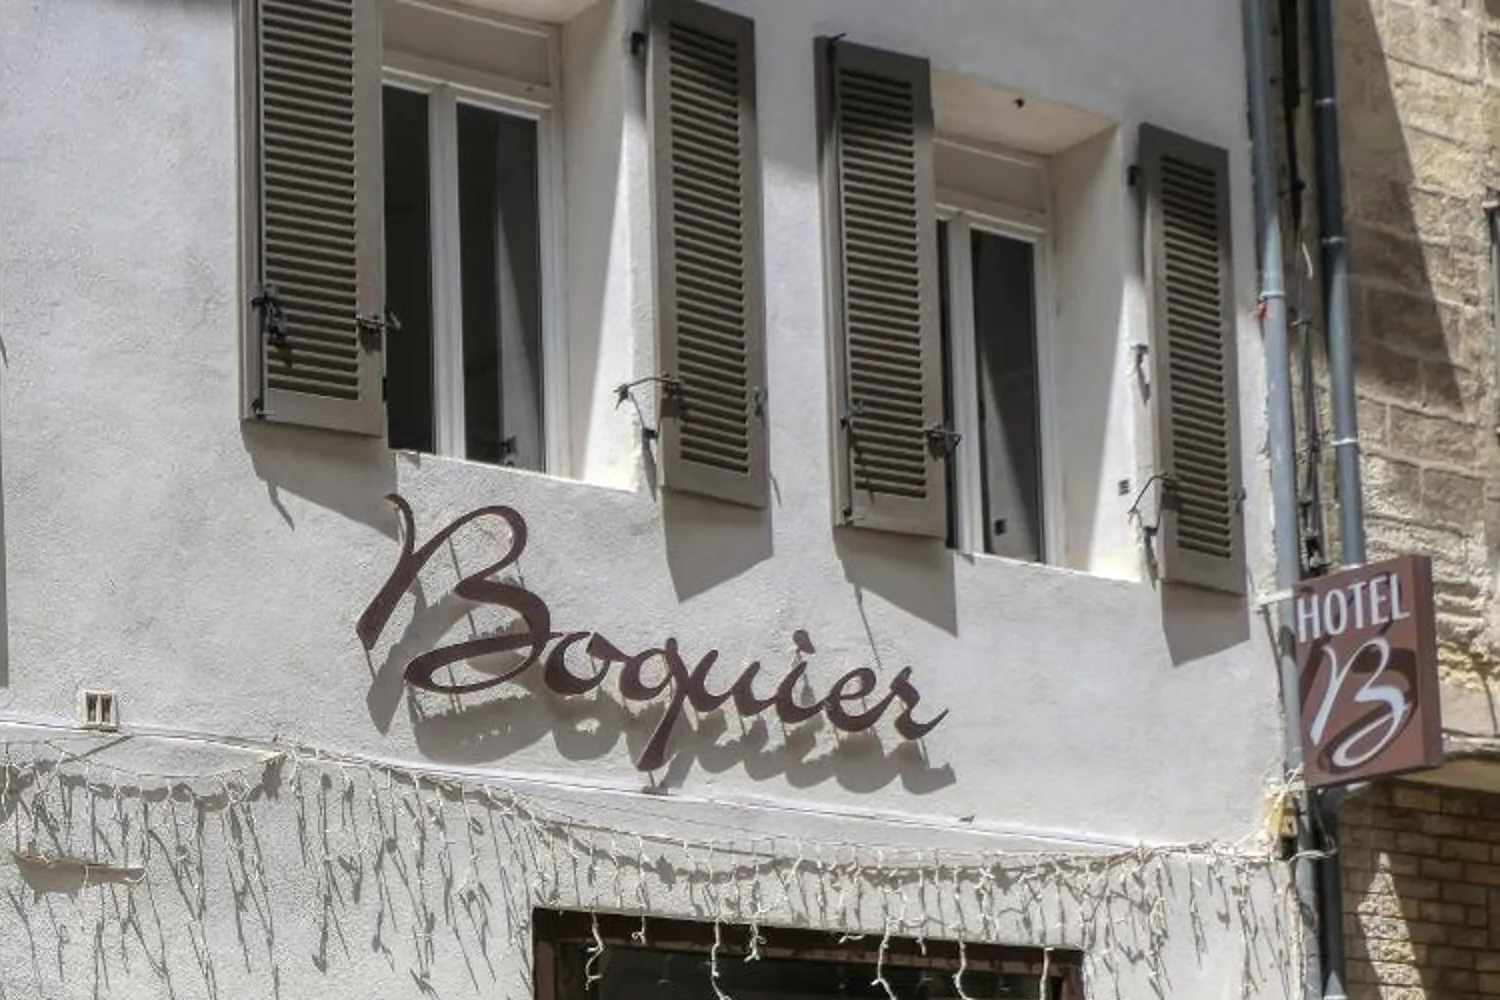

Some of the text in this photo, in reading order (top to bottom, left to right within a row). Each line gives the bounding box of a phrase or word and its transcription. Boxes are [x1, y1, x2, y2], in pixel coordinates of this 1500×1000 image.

[356, 493, 950, 772] Boquier
[1297, 573, 1410, 643] HOTEL
[1309, 636, 1412, 767] B
